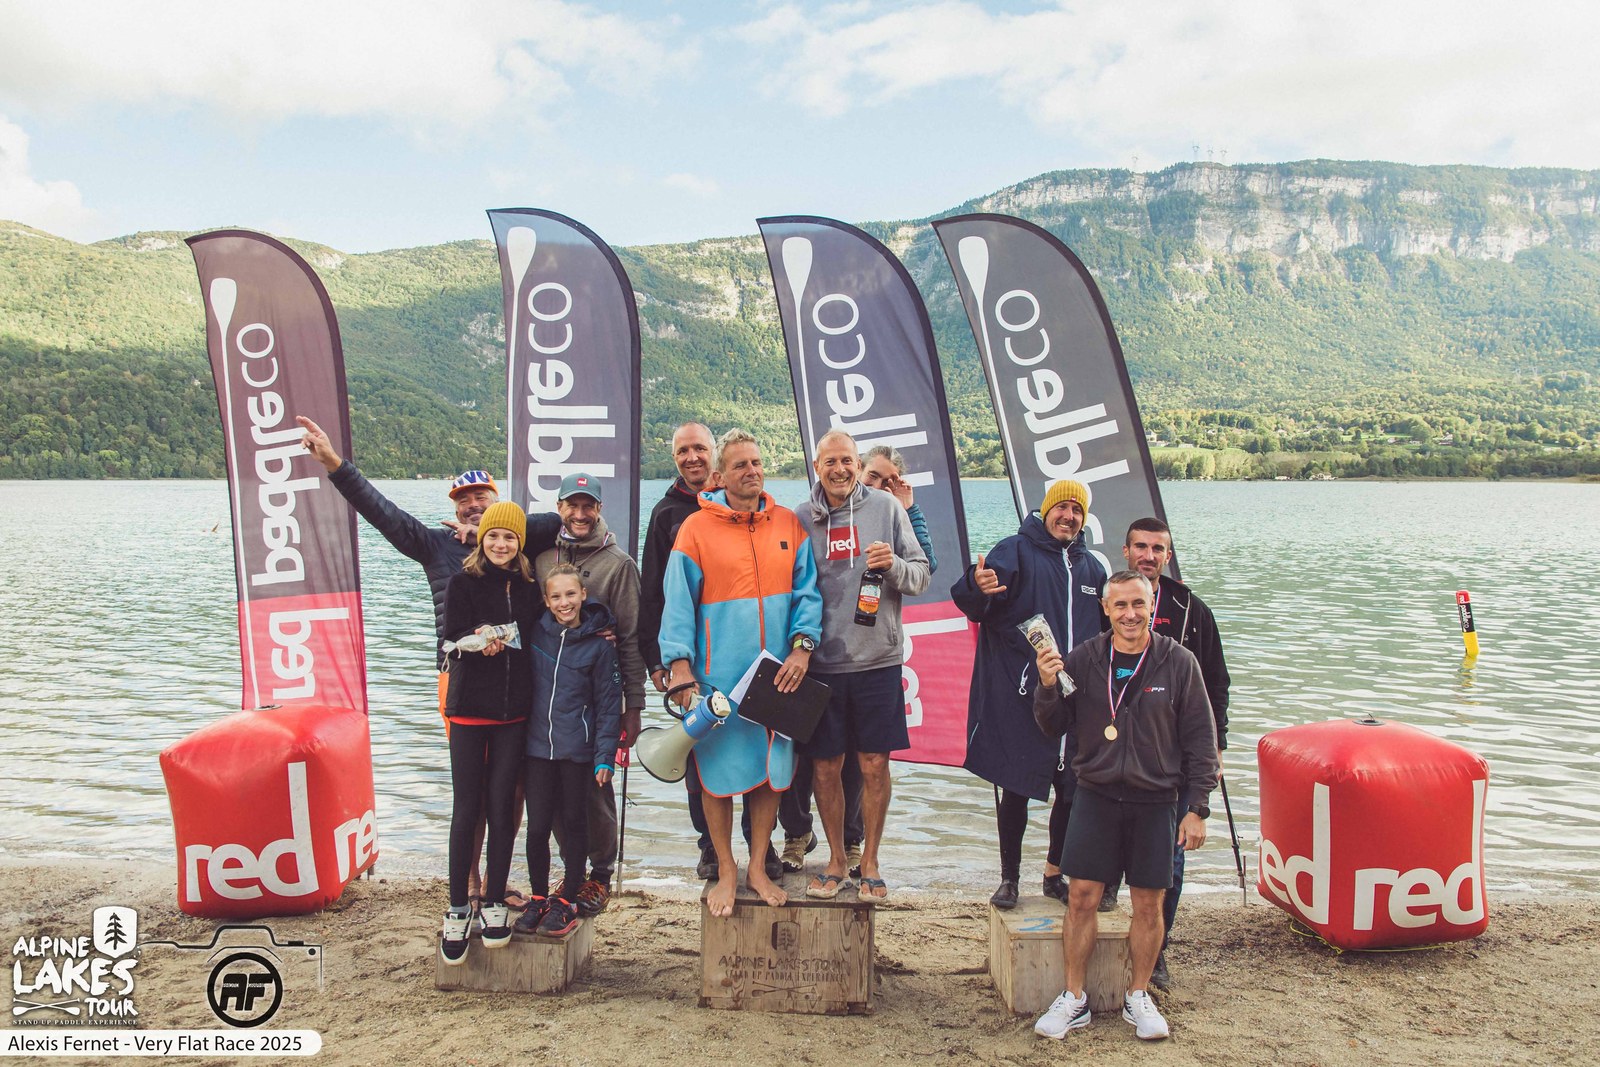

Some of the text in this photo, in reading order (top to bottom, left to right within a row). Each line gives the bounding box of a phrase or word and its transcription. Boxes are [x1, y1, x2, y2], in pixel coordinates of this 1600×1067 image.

[830, 531, 856, 552] red
[185, 761, 319, 902] red
[334, 809, 380, 883] re
[1258, 782, 1331, 925] ed
[1353, 779, 1486, 931] red
